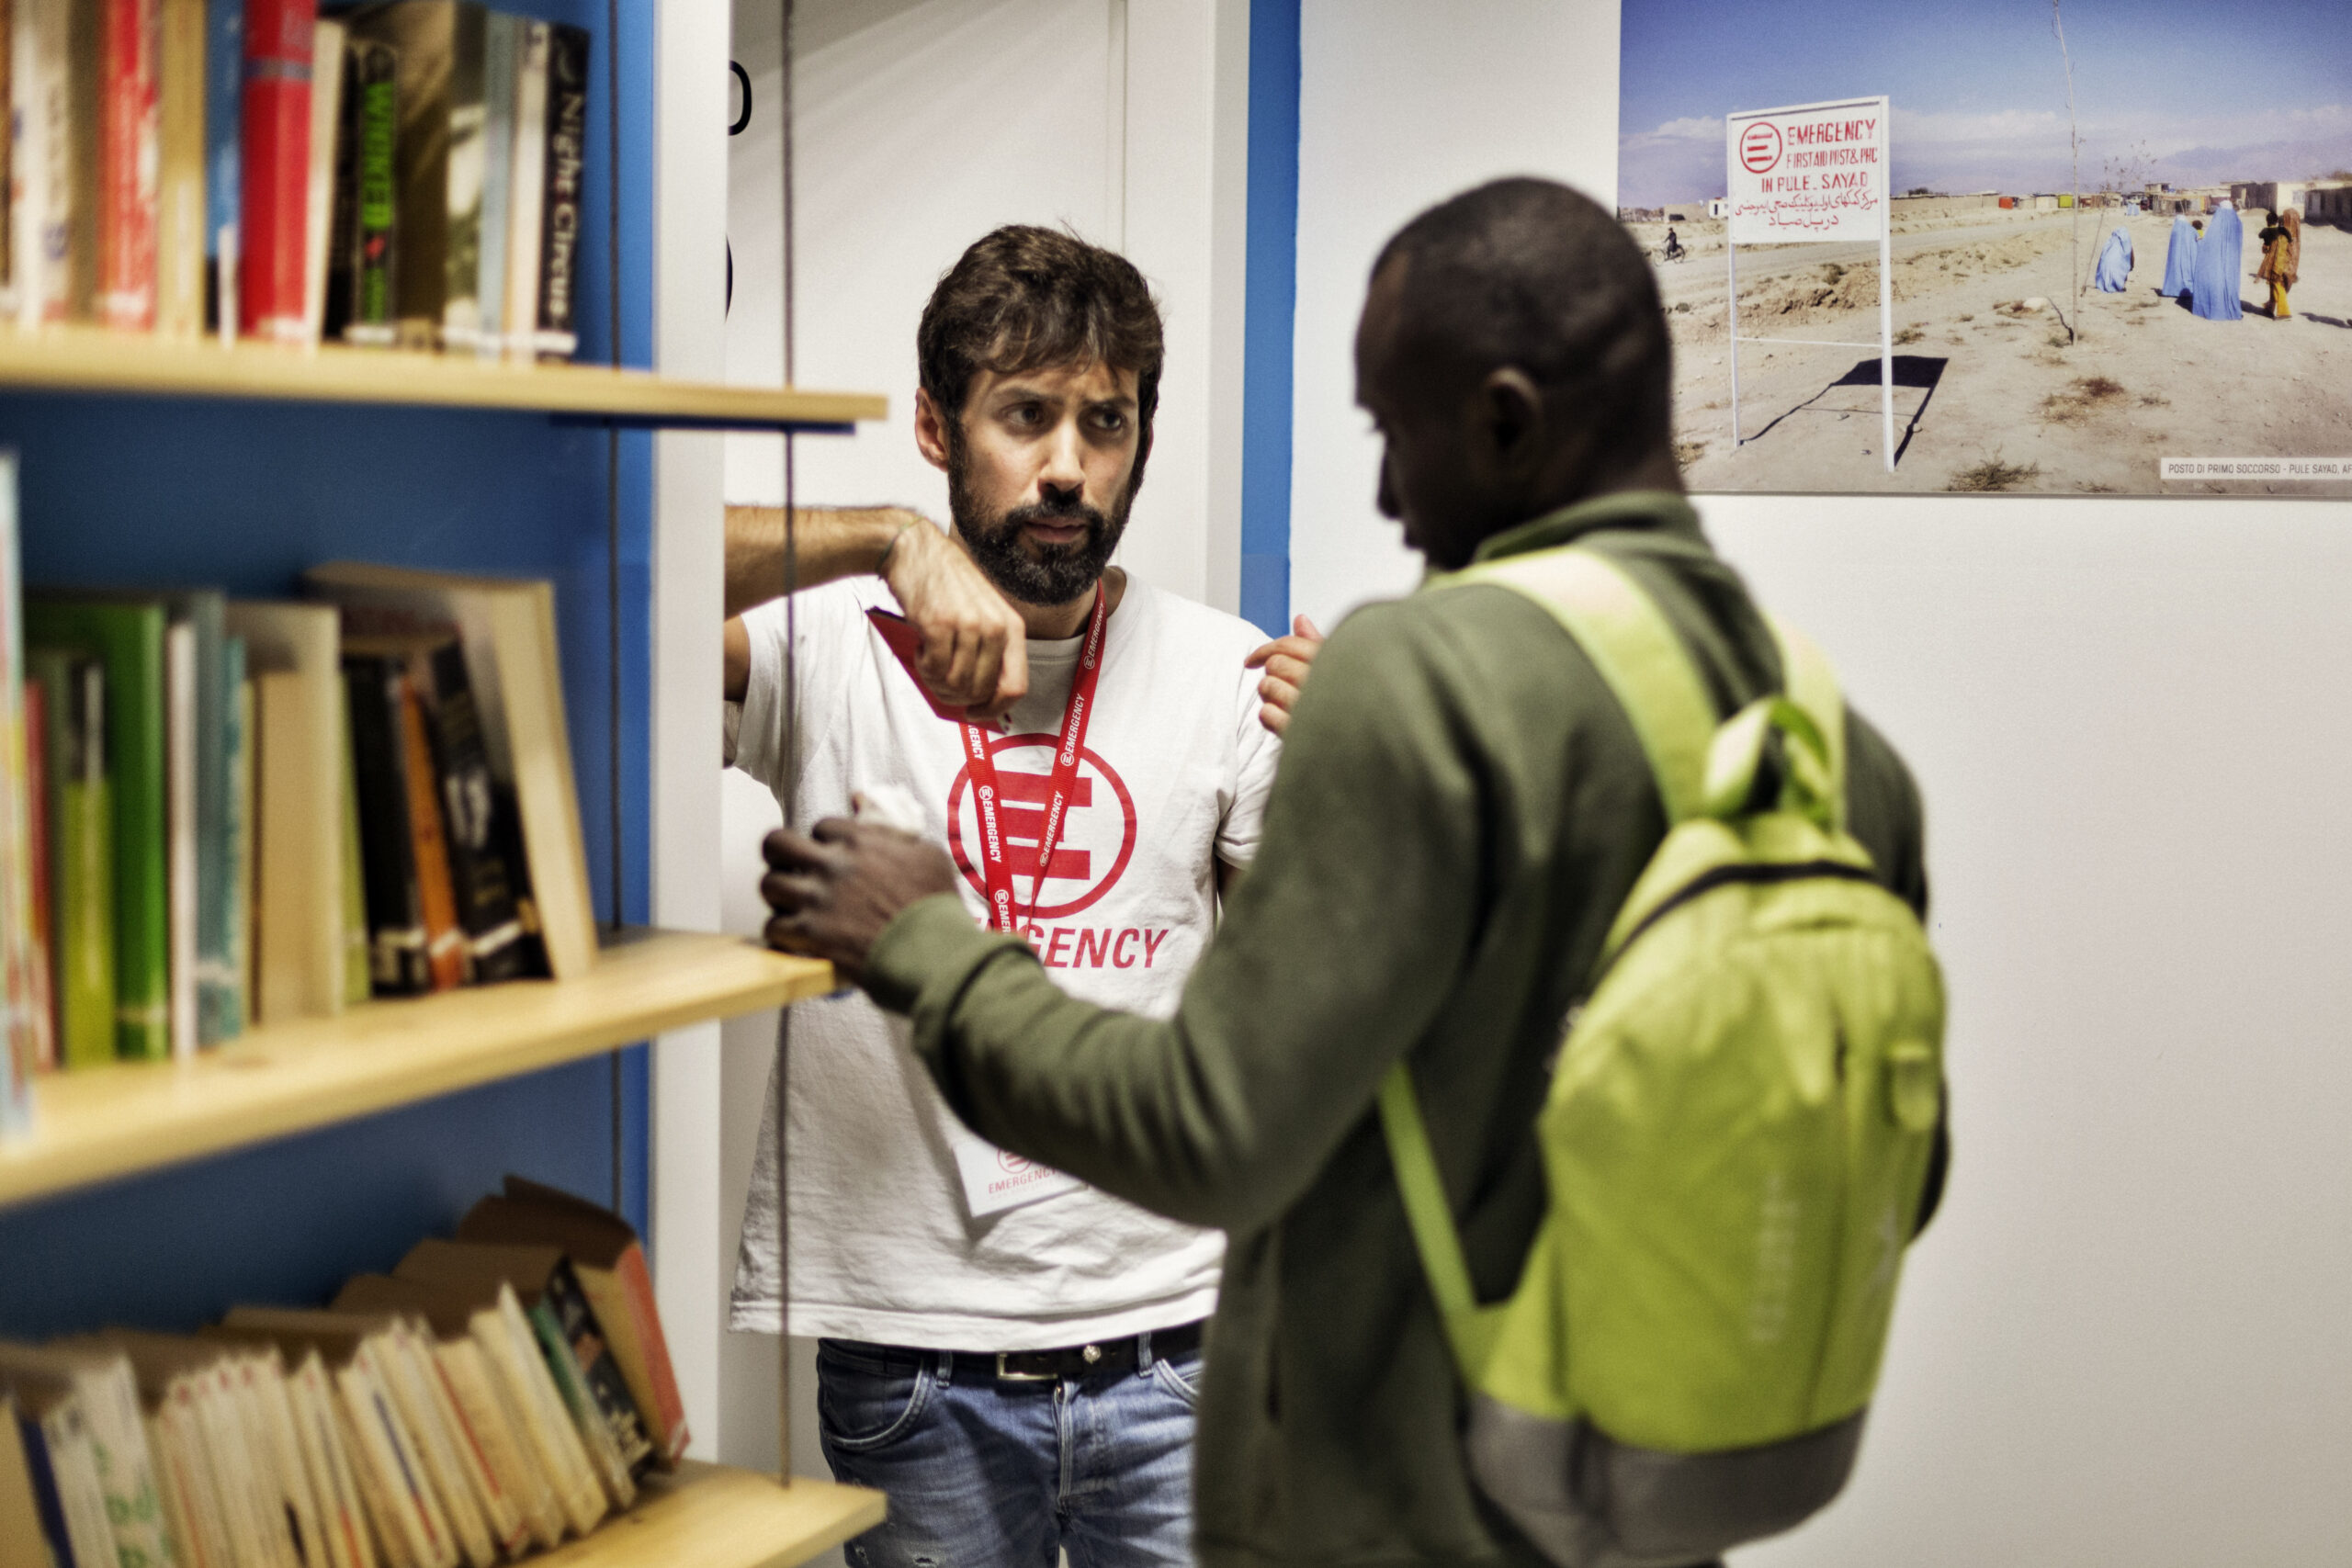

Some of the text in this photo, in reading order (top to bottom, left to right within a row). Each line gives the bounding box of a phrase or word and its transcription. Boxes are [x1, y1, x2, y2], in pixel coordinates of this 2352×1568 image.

[1786, 151, 1815, 169] FIRST
[1860, 147, 1878, 164] PHC
[1787, 118, 1876, 146] EMERGENCY
[549, 93, 584, 318] Night Circus
[1761, 177, 1773, 193] IN
[1822, 172, 1868, 190] SAYAD
[2168, 463, 2195, 474] POSTO
[2197, 463, 2205, 474] DI
[2207, 463, 2234, 474] PRIMO
[2236, 463, 2281, 474] SOCCORSO
[2289, 463, 2310, 474] PULE
[2312, 463, 2340, 475] SAYAD,
[1087, 602, 1104, 658] EMERGENCY
[1064, 693, 1085, 754] EMERGENCY
[982, 800, 1002, 863] EMERGENCY
[1044, 790, 1064, 854] EMERGENCY
[976, 918, 1170, 968] GENCY
